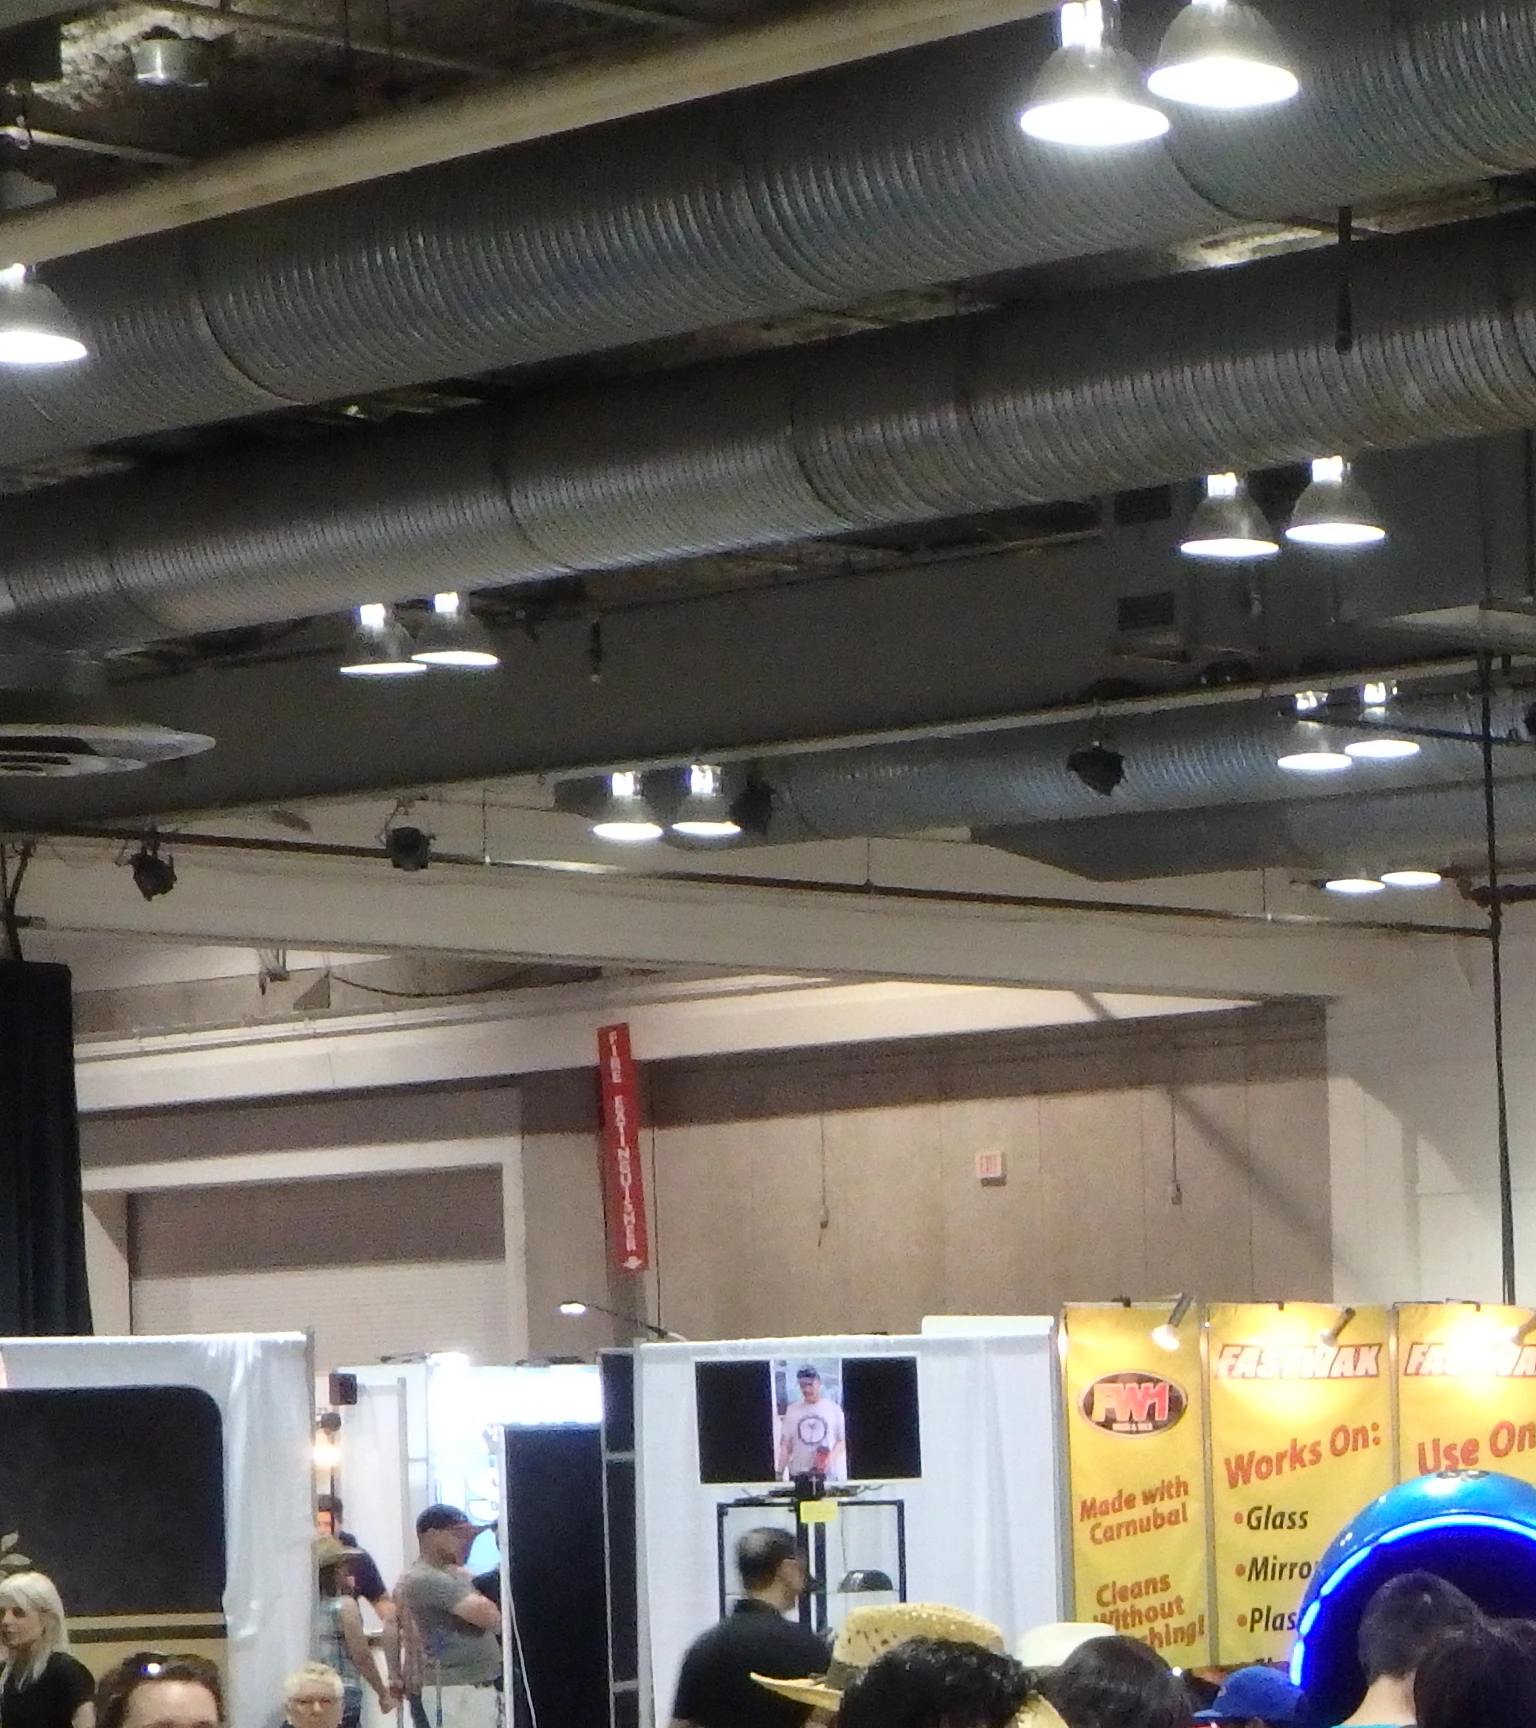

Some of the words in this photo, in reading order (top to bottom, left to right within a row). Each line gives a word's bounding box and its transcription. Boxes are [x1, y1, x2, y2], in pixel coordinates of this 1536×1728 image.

[1224, 1438, 1322, 1489] Works
[1329, 1422, 1381, 1457] On:
[1418, 1438, 1480, 1476] Use
[1080, 1489, 1136, 1522] Made
[1142, 1475, 1189, 1506] with
[1247, 1505, 1309, 1531] Glass
[1247, 1555, 1317, 1582] Mirro
[1096, 1574, 1172, 1608] Cleans
[1250, 1605, 1297, 1633] Plas
